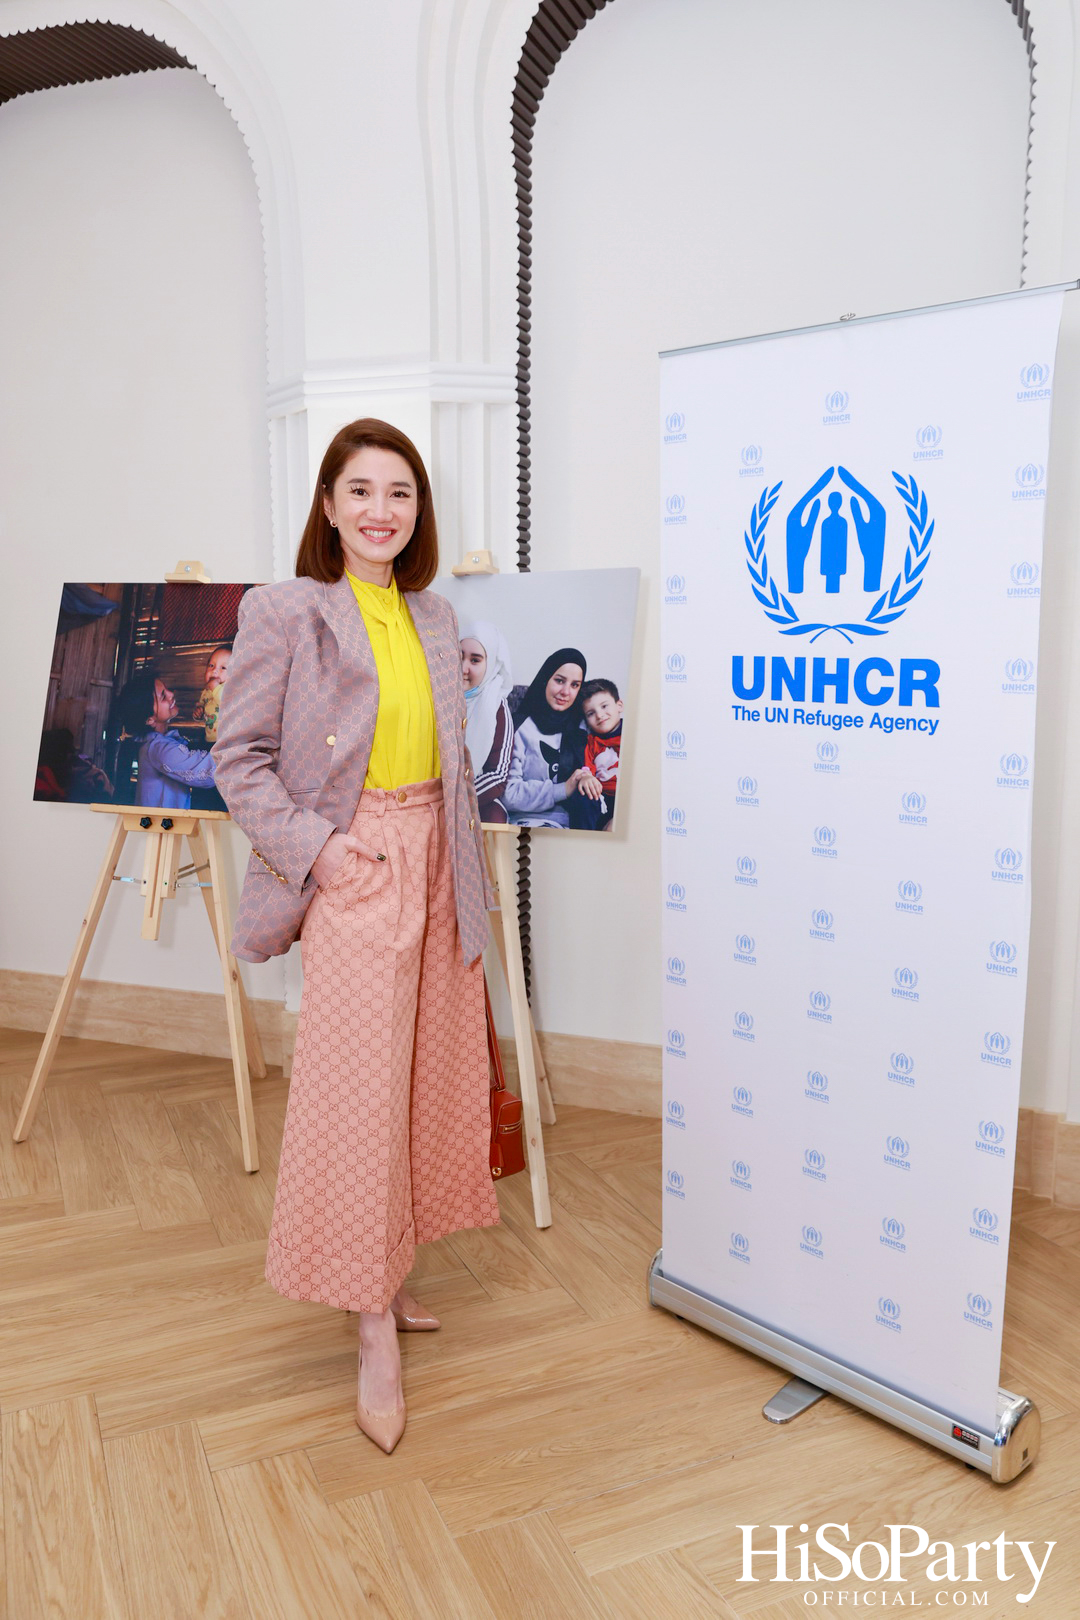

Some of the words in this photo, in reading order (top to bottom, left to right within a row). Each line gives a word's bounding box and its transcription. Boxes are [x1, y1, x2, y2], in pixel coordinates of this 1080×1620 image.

[1017, 389, 1051, 399] UNHCR
[822, 414, 851, 423] UNHCR
[664, 434, 687, 442] UNHCR
[912, 450, 944, 460] UNHCR
[739, 467, 764, 475] UNHCR
[1012, 489, 1046, 499] UNHCR
[664, 515, 687, 523] UNHCR
[1007, 588, 1040, 597] UNHCR
[732, 656, 940, 708] UNHCR
[1002, 683, 1035, 693] UNHCR
[732, 705, 760, 721] The
[765, 707, 789, 723] UN
[794, 708, 864, 730] Refugee
[870, 712, 939, 736] Agency
[814, 763, 840, 772] UNHCR
[996, 777, 1030, 787] UNHCR
[736, 796, 759, 805] UNHCR
[899, 814, 928, 824] UNHCR
[666, 827, 687, 835] UNHCR
[812, 846, 838, 856] UNHCR
[734, 876, 758, 885] UNHCR
[991, 871, 1024, 882] UNHCR
[666, 902, 687, 910] UNHCR
[895, 902, 924, 913] UNHCR
[809, 930, 835, 940] UNHCR
[733, 953, 757, 962] UNHCR
[986, 963, 1018, 974] UNHCR
[666, 975, 687, 984] UNHCR
[891, 988, 920, 999] UNHCR
[807, 1010, 832, 1021] UNHCR
[732, 1029, 755, 1039] UNHCR
[666, 1048, 686, 1057] UNHCR
[981, 1053, 1012, 1065] UNHCR
[888, 1072, 915, 1085] UNHCR
[804, 1089, 830, 1101] UNHCR
[731, 1104, 754, 1115] UNHCR
[975, 1141, 1006, 1155] UNHCR
[884, 1155, 911, 1168] UNHCR
[802, 1167, 826, 1180] UNHCR
[730, 1177, 752, 1190] UNHCR
[666, 1186, 685, 1198] UNHCR
[969, 1227, 999, 1242] UNHCR
[880, 1236, 906, 1250] UNHCR
[800, 1242, 824, 1257] UNHCR
[729, 1248, 750, 1262] UNHCR
[875, 1315, 901, 1330] UNHCR
[964, 1312, 993, 1328] UNHCR
